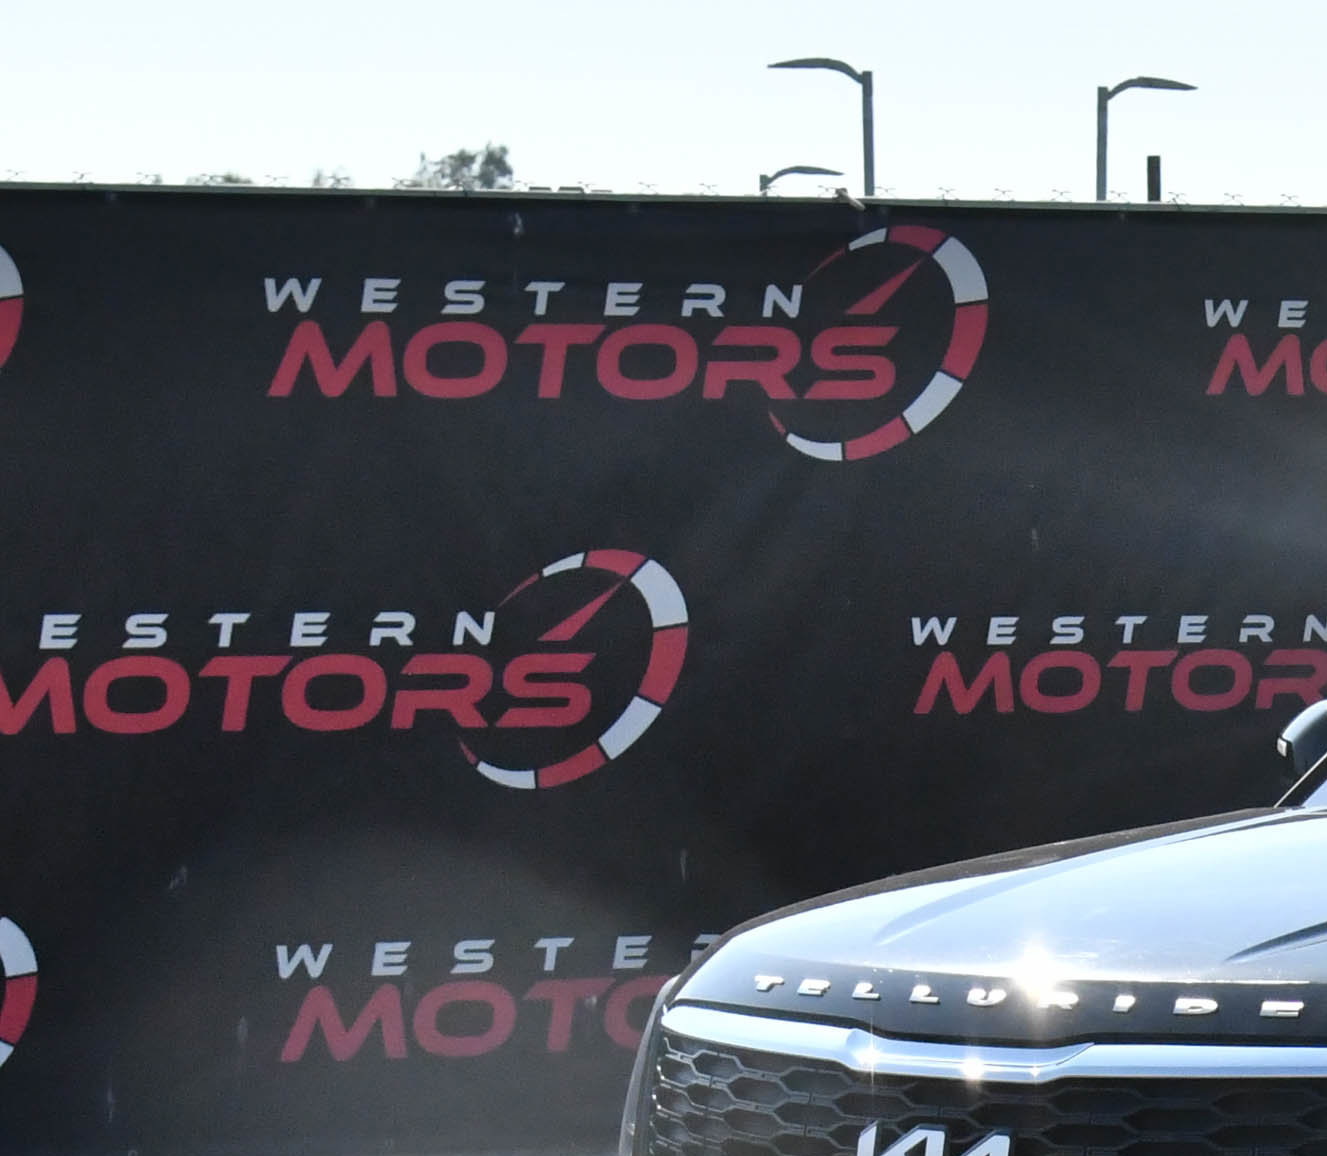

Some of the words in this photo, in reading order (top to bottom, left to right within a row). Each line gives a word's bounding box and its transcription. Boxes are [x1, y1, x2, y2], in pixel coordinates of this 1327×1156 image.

[264, 278, 803, 318] WESTERN
[267, 319, 898, 400] MOTORS
[0, 651, 597, 736] MOTORS
[754, 974, 1305, 1018] TELLURIDE
